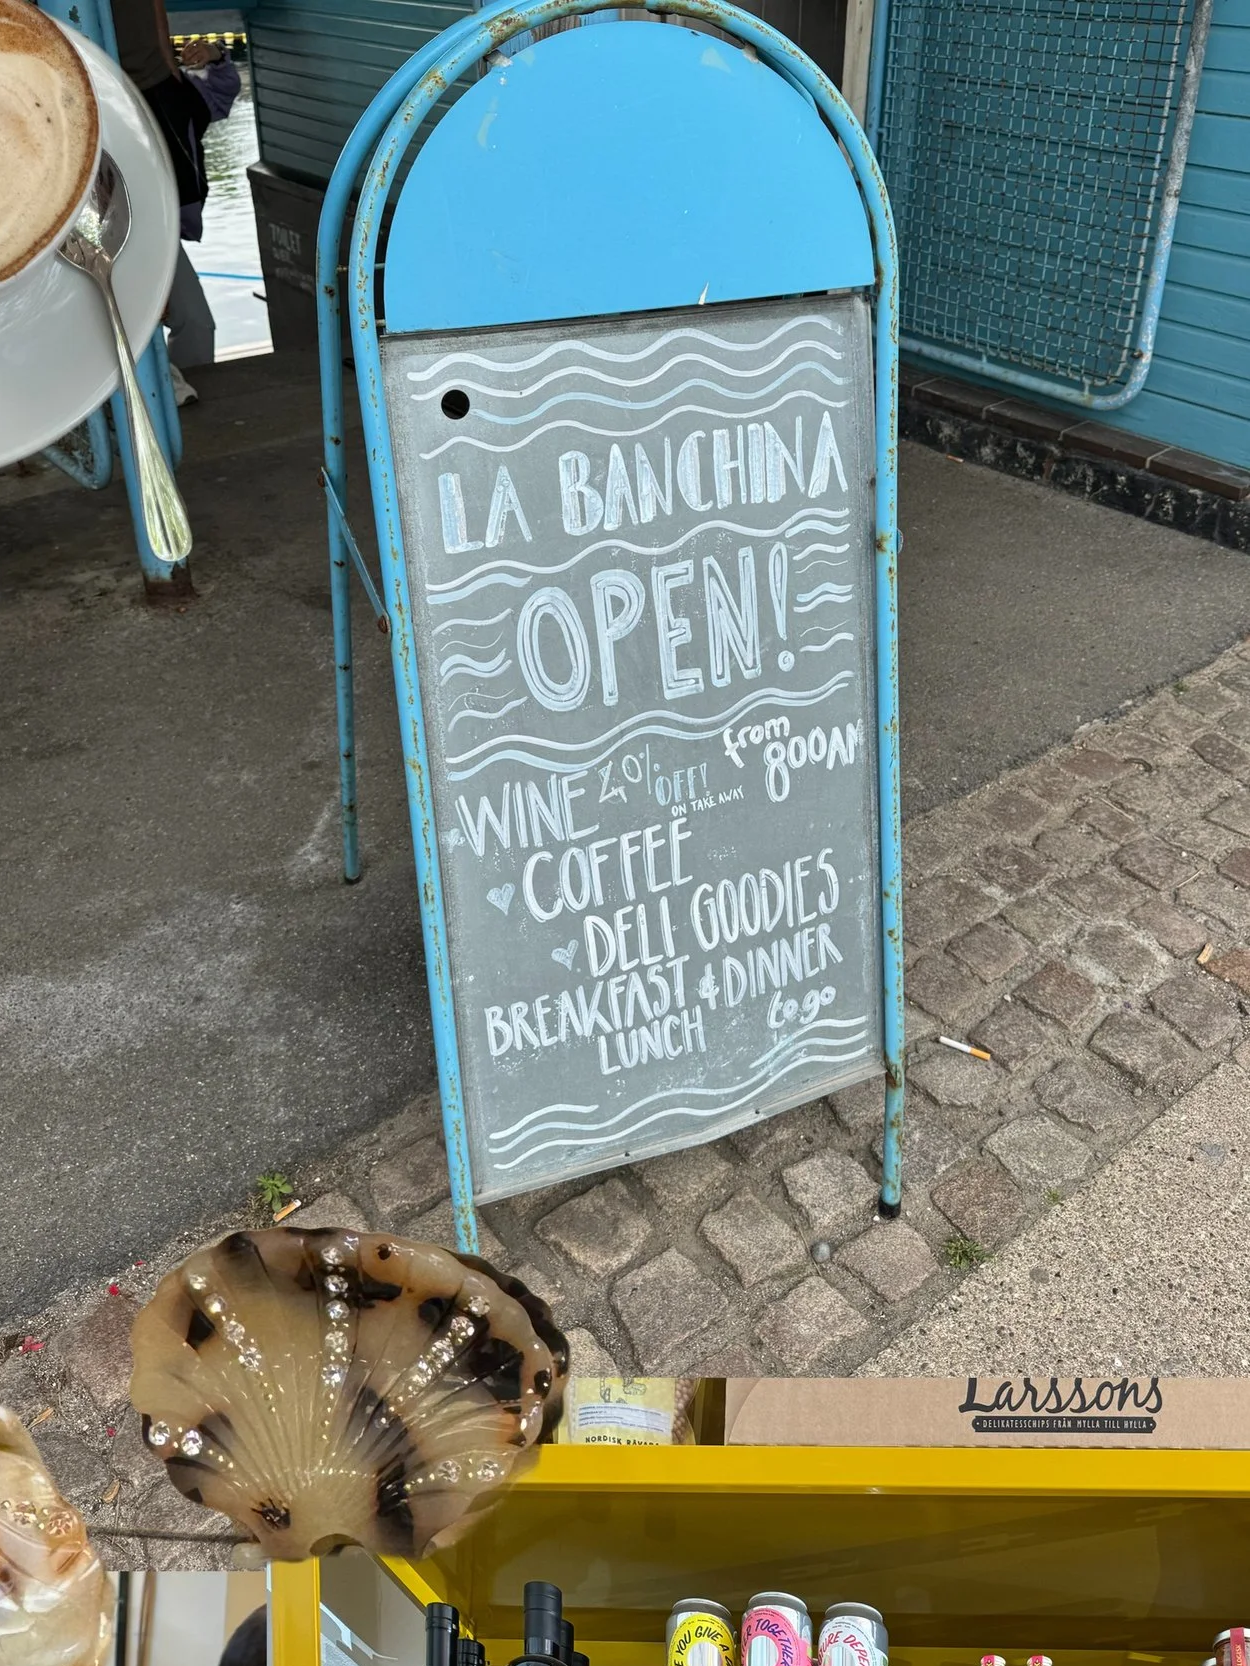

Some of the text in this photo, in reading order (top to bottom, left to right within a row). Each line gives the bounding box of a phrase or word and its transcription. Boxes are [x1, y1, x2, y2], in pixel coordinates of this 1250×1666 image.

[437, 410, 849, 554] LA BANCHINA
[516, 541, 796, 712] OPEN!
[723, 715, 790, 769] from
[655, 762, 710, 806] OFF!
[671, 785, 745, 817] ON TAKE AWAY
[454, 771, 600, 857] WINE
[522, 817, 693, 923] COFFEE
[583, 848, 841, 978] DELI GOODIES
[483, 954, 691, 1057] BREAKFAST
[722, 922, 843, 1008] DINNER
[766, 985, 837, 1029] to go
[598, 1004, 707, 1076] LUNCH
[958, 1378, 1163, 1413] Larssons
[982, 1419, 1050, 1428] DELIKATESSCHIPS
[1053, 1417, 1072, 1428] FRÅN
[1104, 1420, 1121, 1428] TILL
[585, 1436, 622, 1445] NORDISK
[676, 1630, 691, 1655] YOU
[695, 1626, 723, 1641] GIVE
